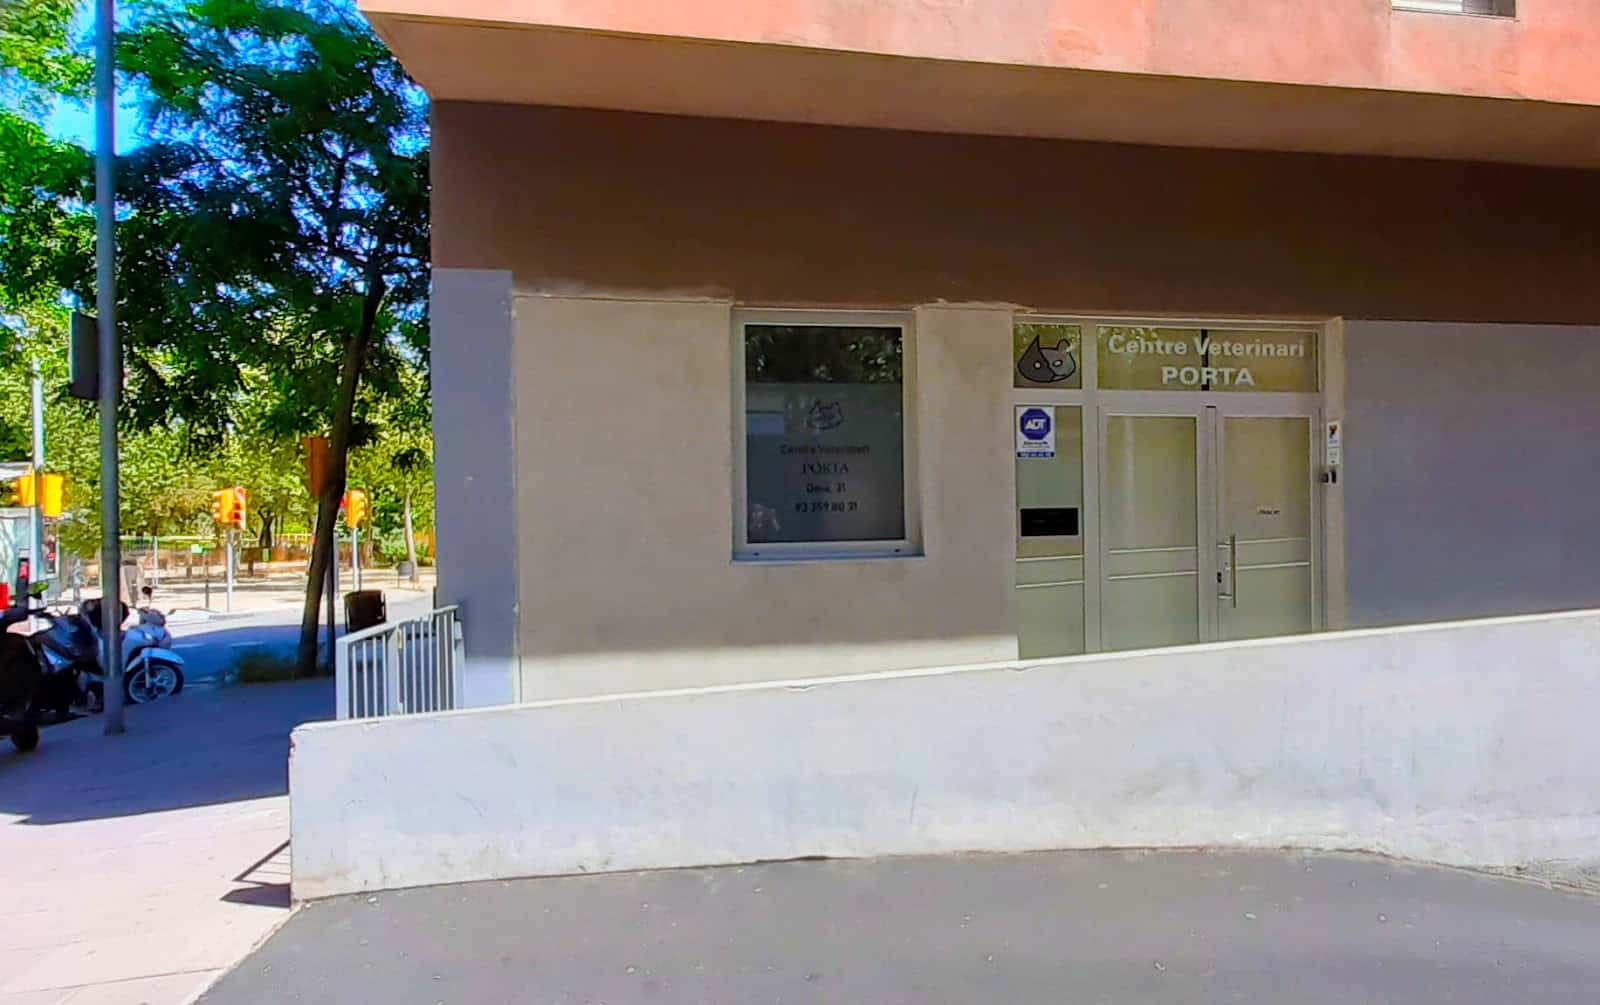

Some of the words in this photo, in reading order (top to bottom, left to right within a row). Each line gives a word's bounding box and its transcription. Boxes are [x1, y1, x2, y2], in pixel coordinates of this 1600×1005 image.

[1108, 335, 1188, 355] Centre
[1194, 337, 1305, 358] Veterinari
[1161, 366, 1255, 386] PORTA
[1024, 418, 1046, 431] ADT
